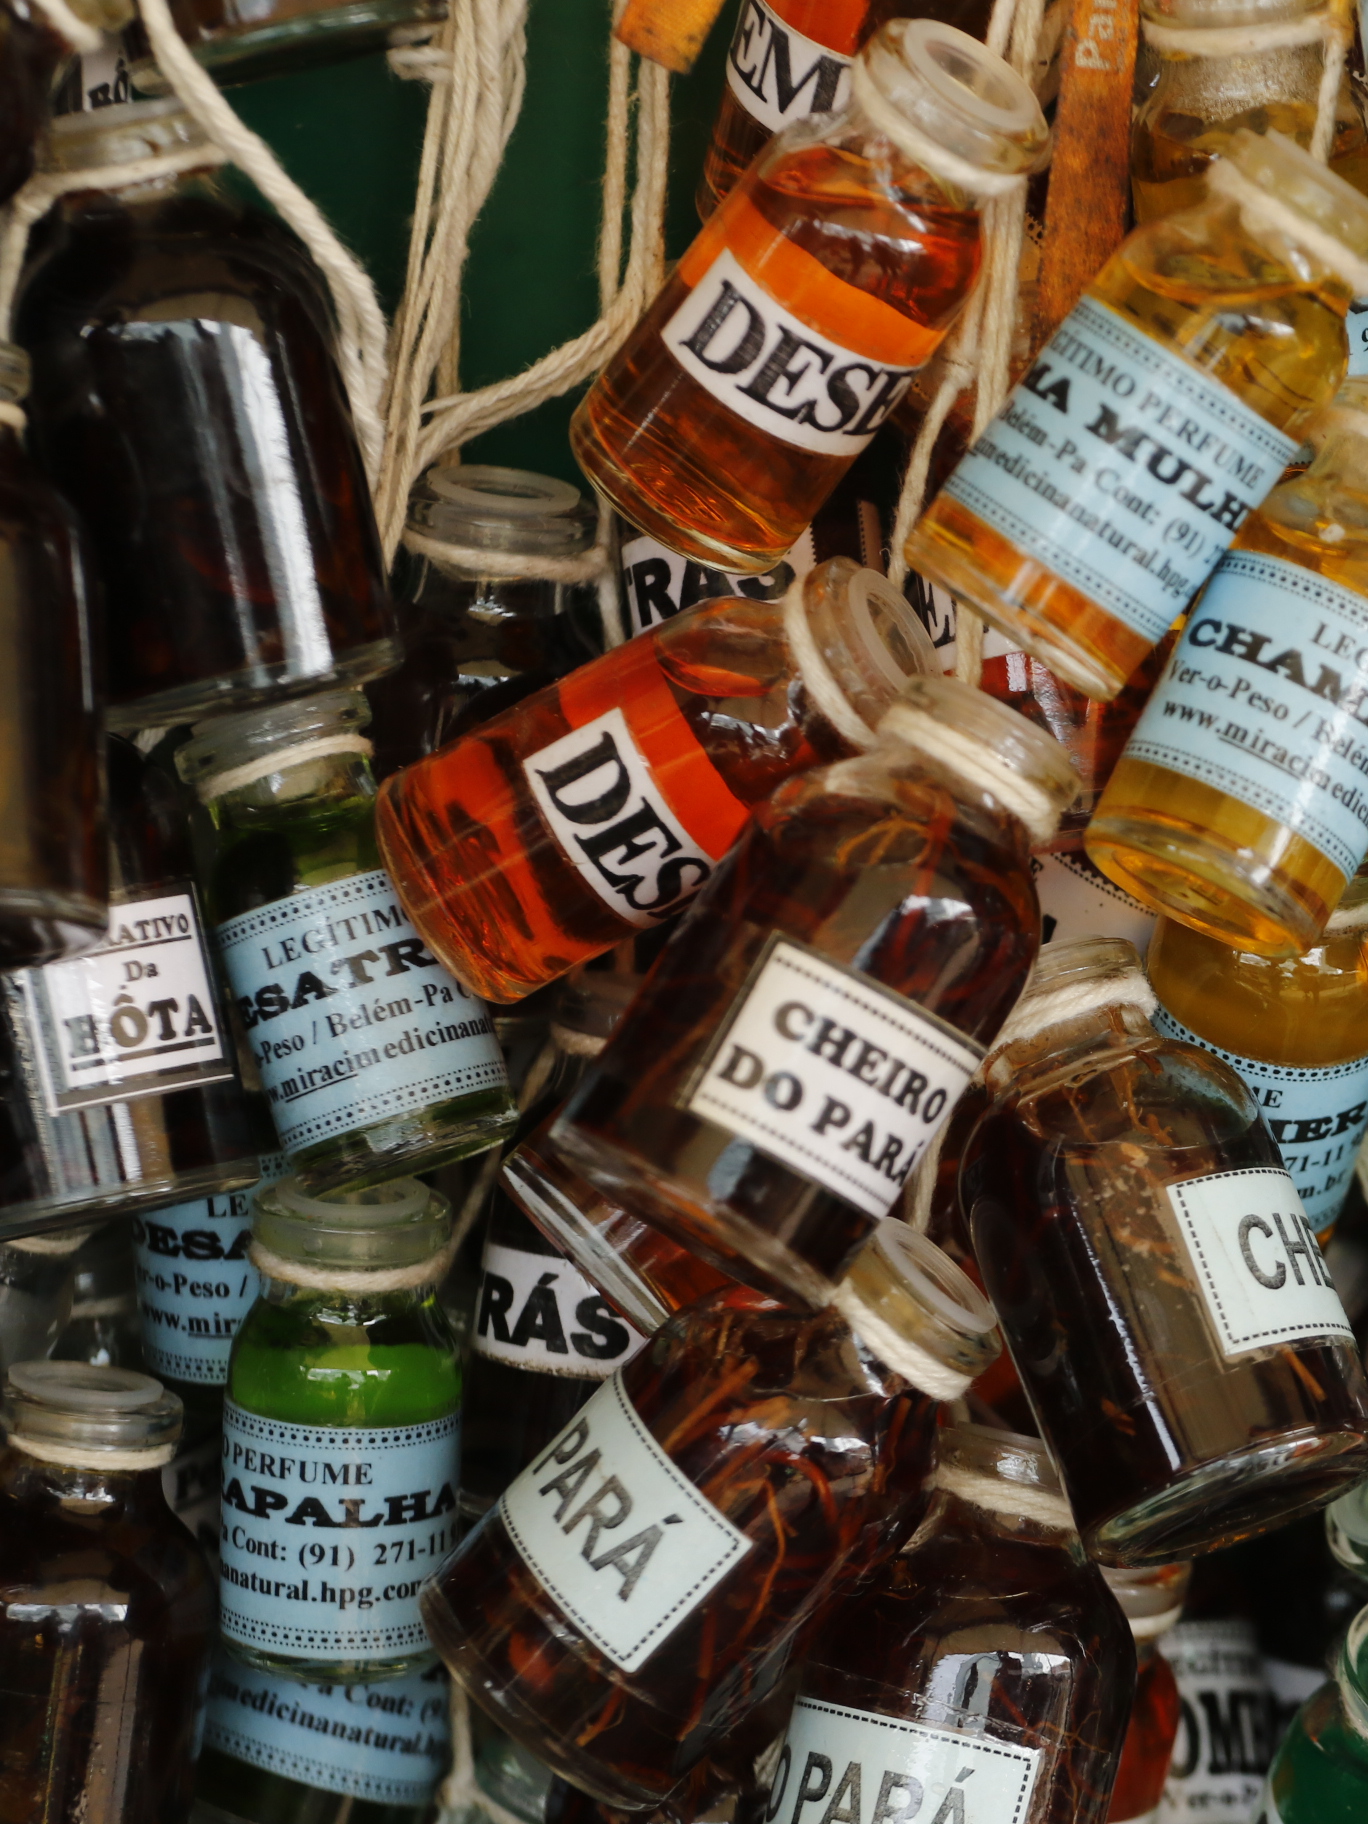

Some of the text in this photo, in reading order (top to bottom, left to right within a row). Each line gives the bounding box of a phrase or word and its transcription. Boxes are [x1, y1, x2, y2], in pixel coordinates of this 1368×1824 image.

[109, 912, 189, 946] ATIVO
[122, 959, 159, 983] Da
[716, 1042, 805, 1112] DO
[772, 1000, 948, 1125] CHEIRO
[232, 1441, 374, 1486] PERFUME
[220, 1471, 457, 1529] APALHA
[532, 1414, 685, 1603] PARÁ
[231, 1524, 287, 1562] Cont:
[297, 1541, 355, 1572] (91)
